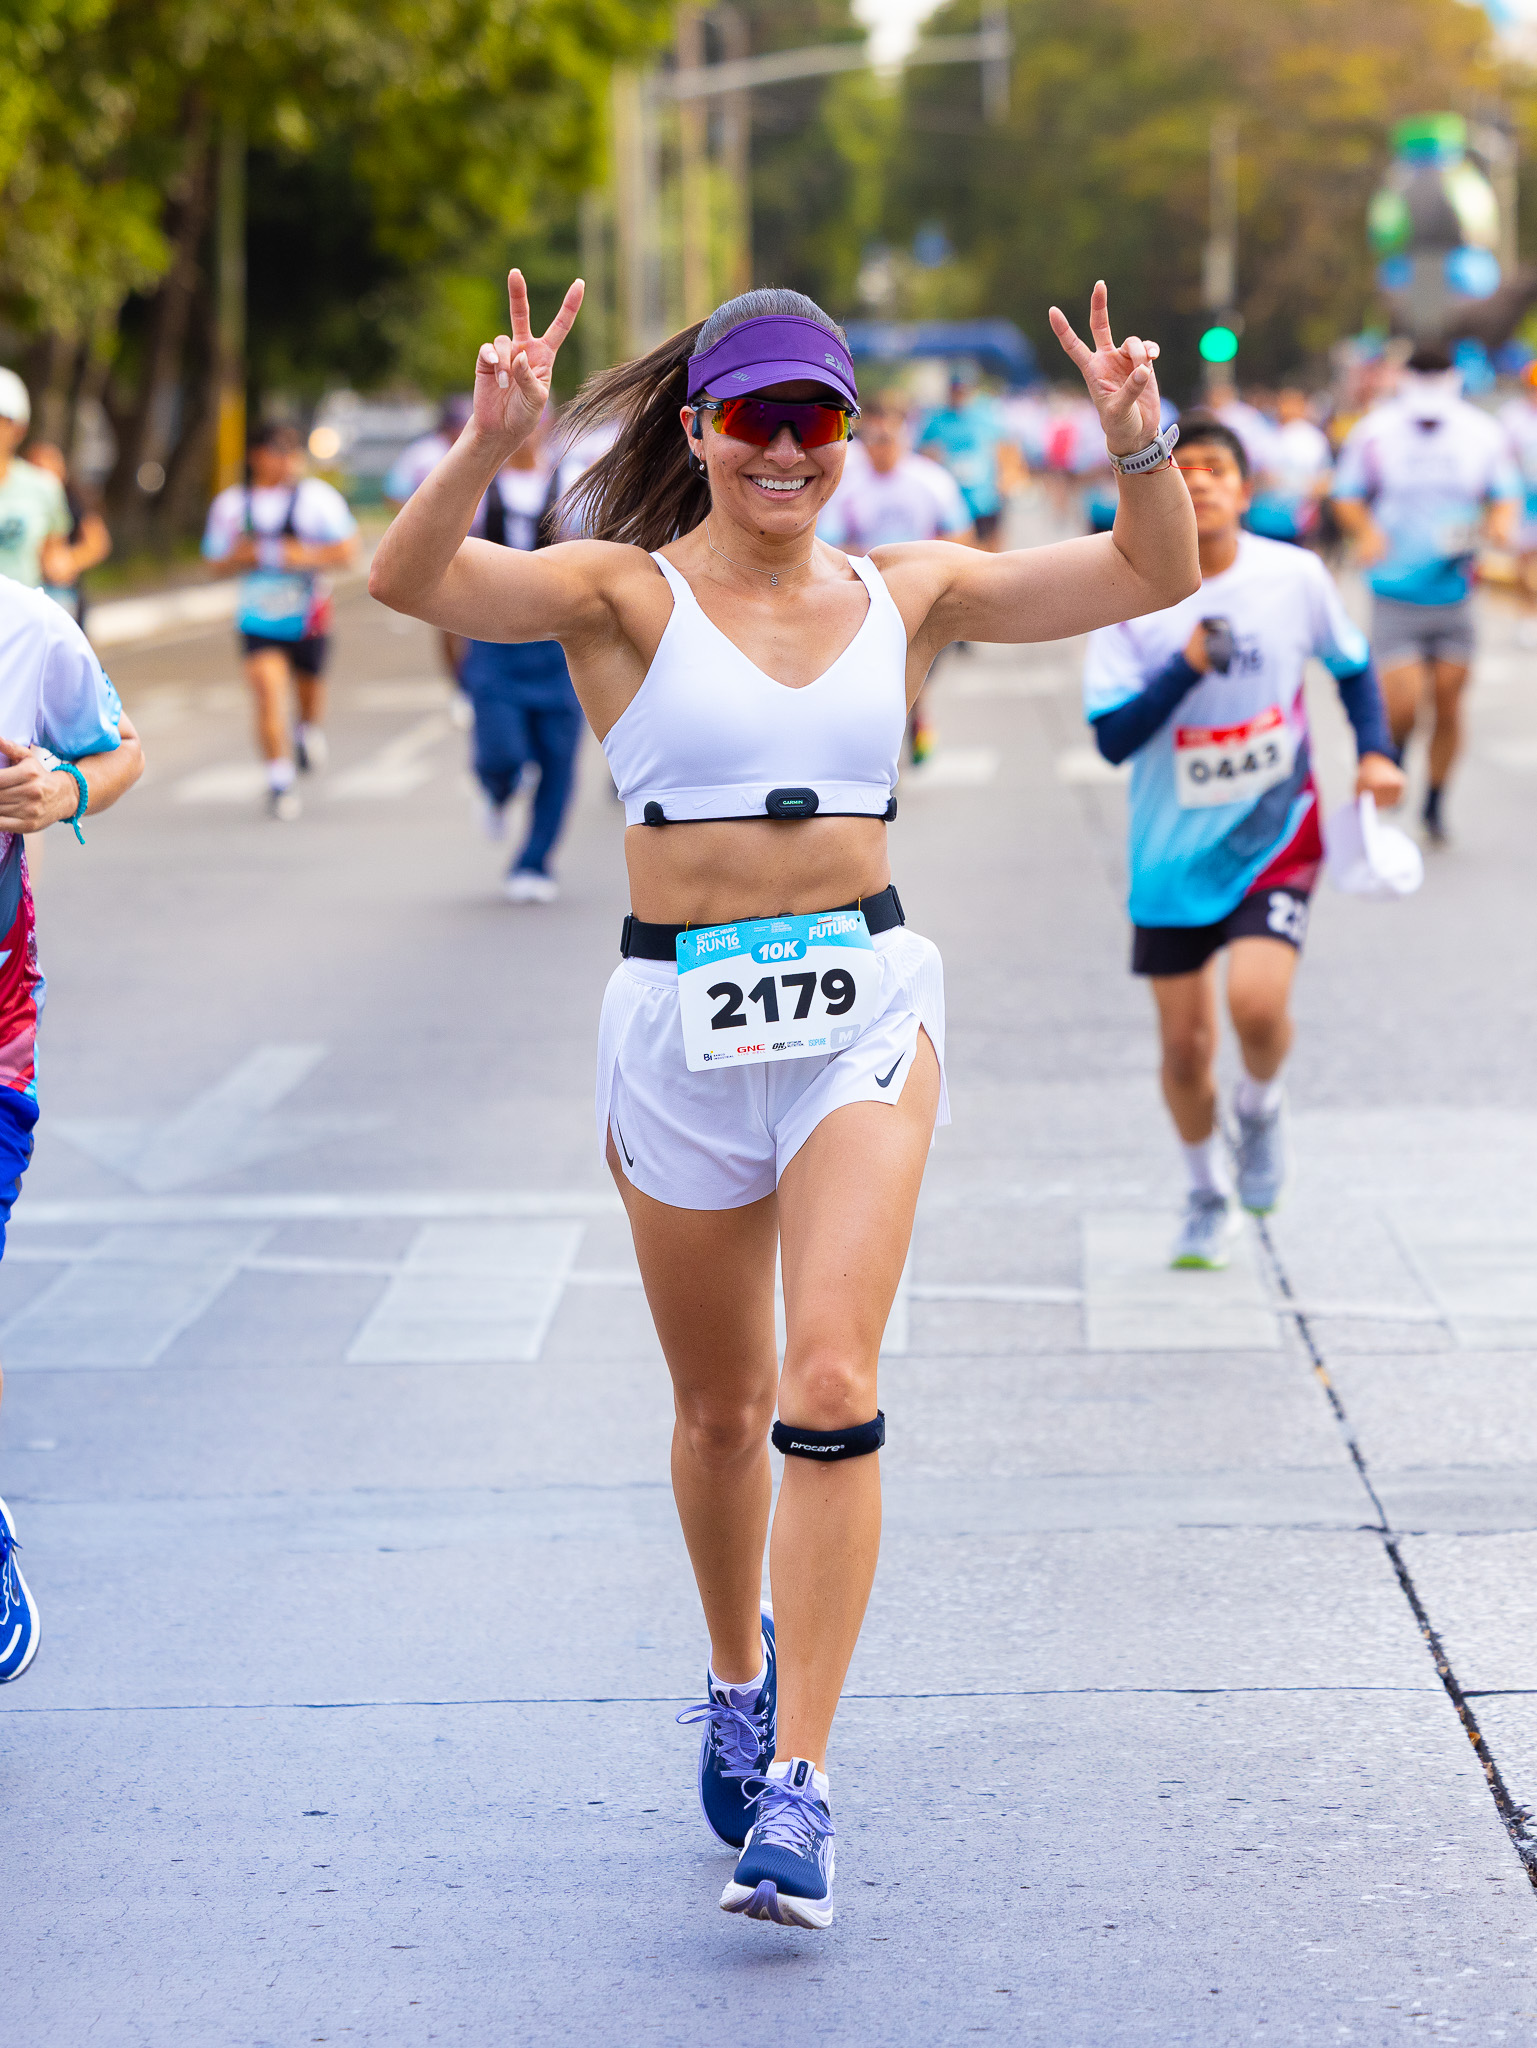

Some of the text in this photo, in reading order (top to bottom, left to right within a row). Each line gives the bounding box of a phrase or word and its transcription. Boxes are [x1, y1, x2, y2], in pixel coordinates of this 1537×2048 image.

[824, 352, 851, 380] 2XU
[731, 371, 751, 381] 2XU
[696, 930, 721, 941] GNC
[808, 918, 857, 940] FUTURO
[696, 932, 740, 956] RUN16
[758, 940, 799, 960] 10K
[706, 968, 856, 1030] 2179
[808, 1037, 826, 1046] ISOPURE
[838, 1030, 853, 1043] M
[737, 1043, 765, 1053] GNC
